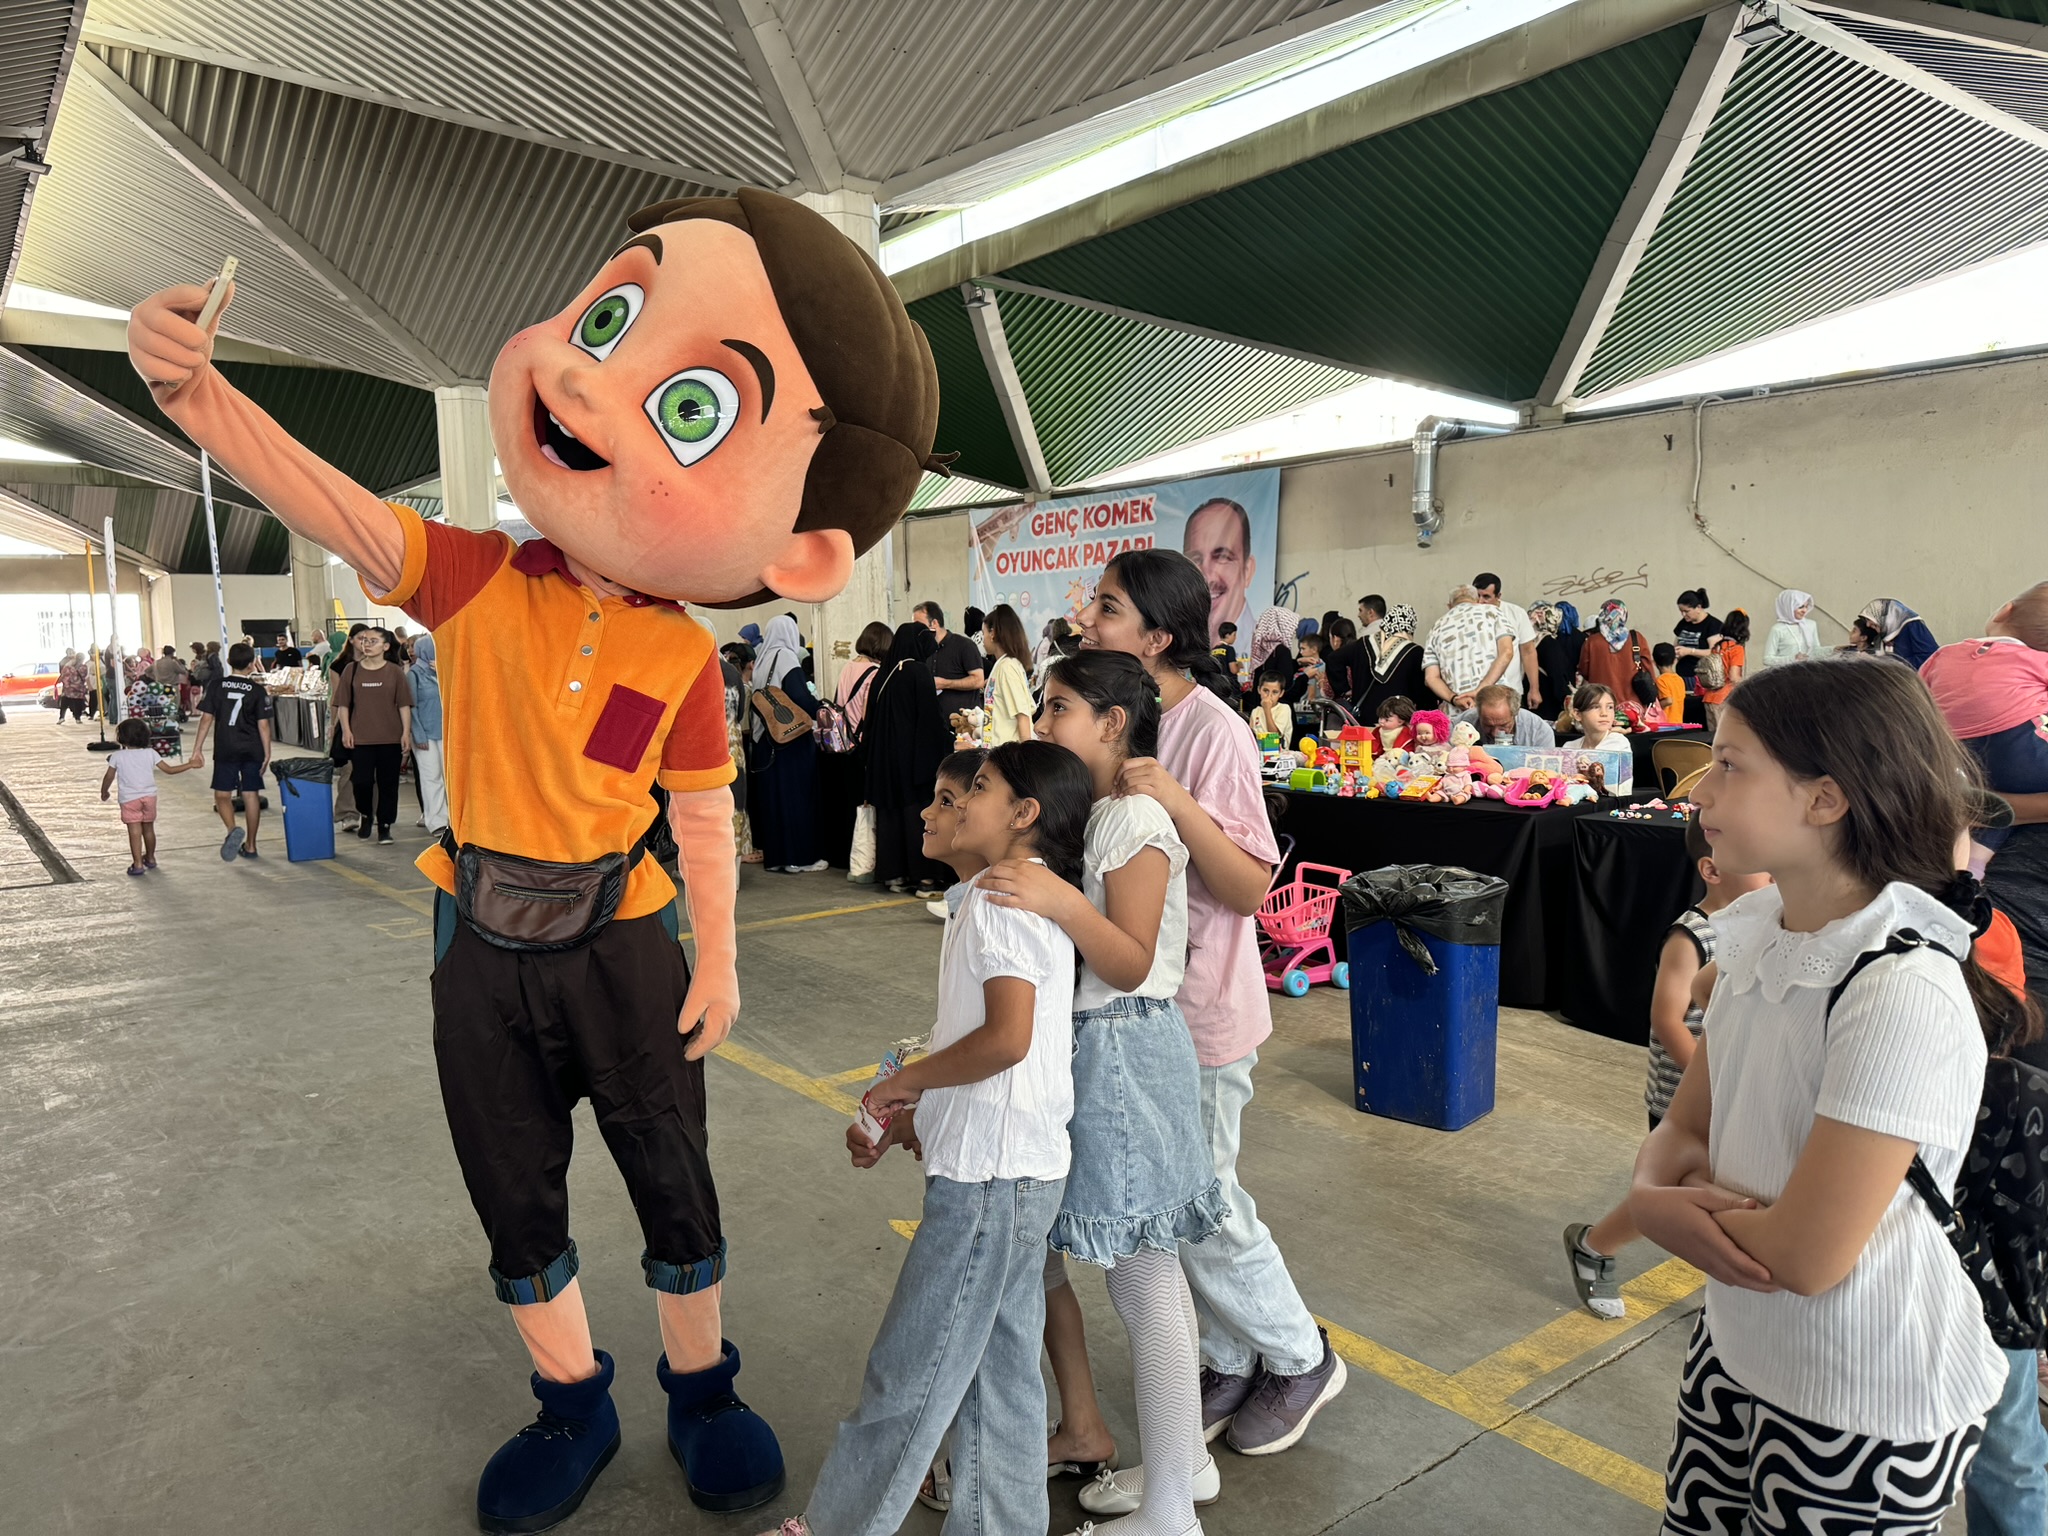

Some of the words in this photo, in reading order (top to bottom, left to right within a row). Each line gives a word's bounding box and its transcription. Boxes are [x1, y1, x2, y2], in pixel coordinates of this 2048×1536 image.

[1031, 508, 1079, 538] GENÇ
[1083, 497, 1154, 529] KOMEK
[996, 544, 1079, 574] OYUNCAK
[222, 681, 252, 691] RONALDO
[227, 692, 245, 726] 7
